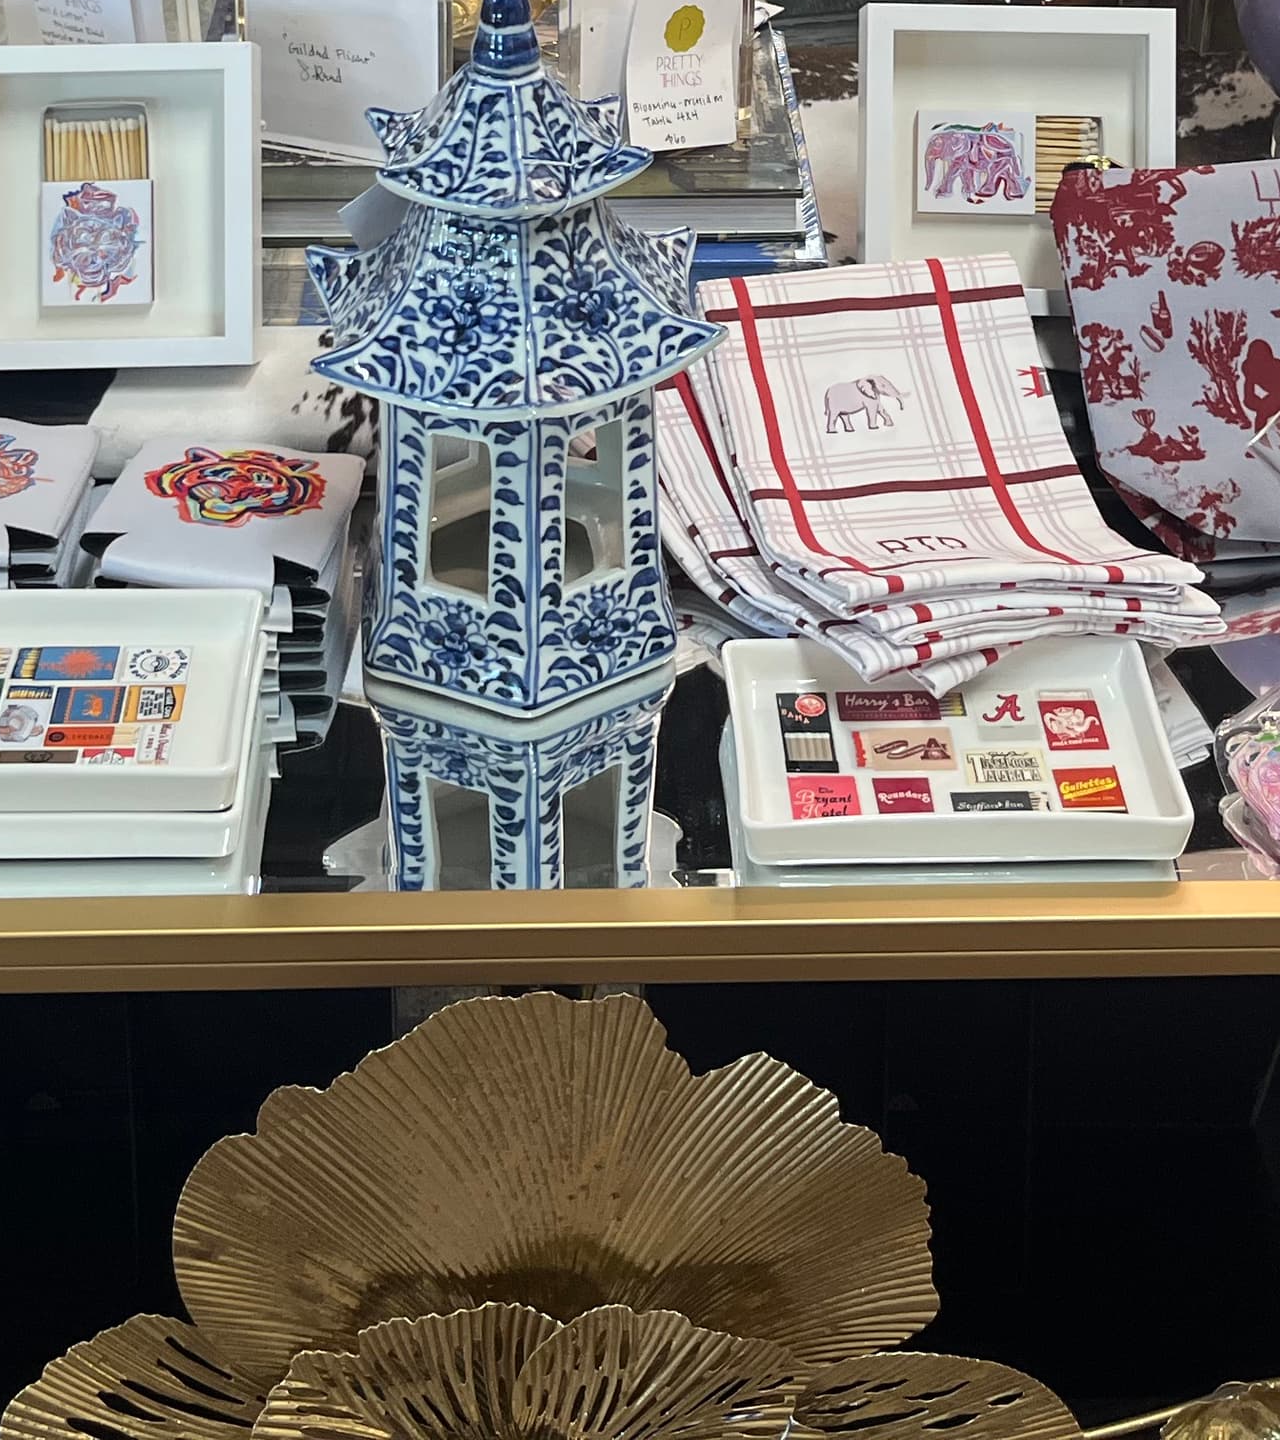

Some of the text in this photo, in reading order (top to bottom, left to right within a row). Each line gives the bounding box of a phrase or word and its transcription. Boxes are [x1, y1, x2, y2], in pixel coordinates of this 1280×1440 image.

[656, 53, 704, 71] PRETTY
[660, 70, 703, 88] THINGS
[844, 693, 930, 711] Harry's Bar
[982, 693, 1025, 722] A
[794, 789, 852, 808] Bryant
[878, 790, 931, 805] Rounders
